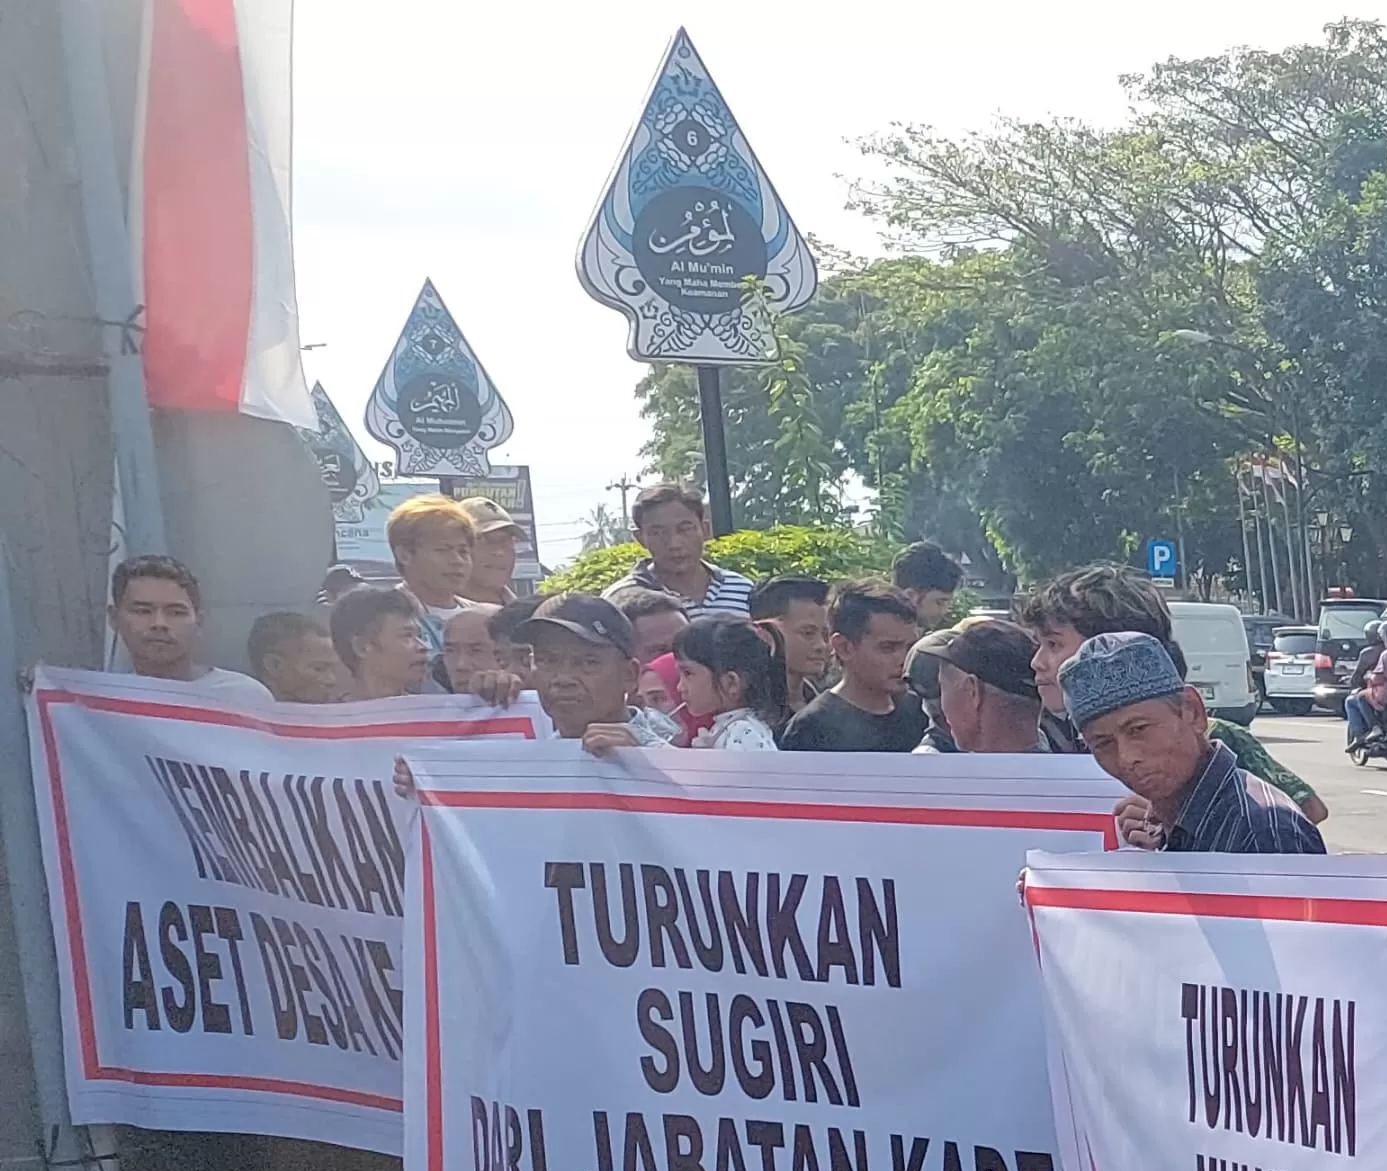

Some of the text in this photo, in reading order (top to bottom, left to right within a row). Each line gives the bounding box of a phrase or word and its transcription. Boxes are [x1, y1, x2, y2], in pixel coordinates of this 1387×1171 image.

[687, 131, 698, 146] 6
[671, 261, 684, 272] Al
[1154, 545, 1171, 571] P
[122, 900, 255, 1036] ASET
[249, 911, 378, 1057] DESA
[544, 861, 902, 988] TURUNKAN
[637, 988, 861, 1107] SUGIRI
[1181, 983, 1357, 1157] TURUNKAN
